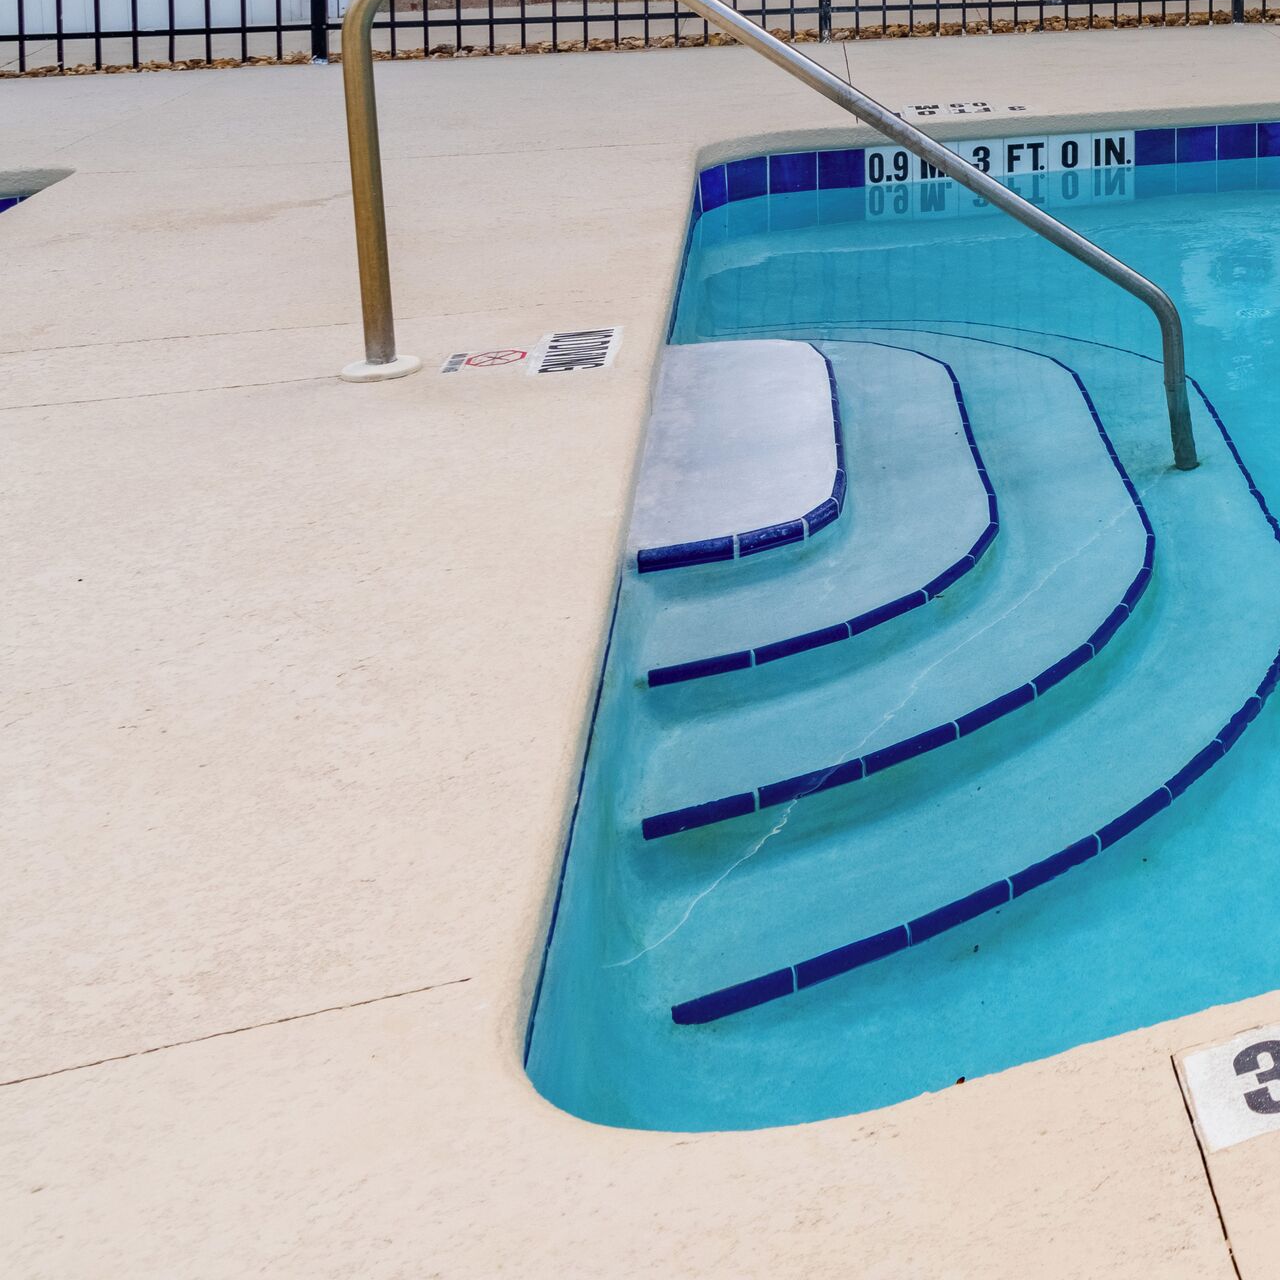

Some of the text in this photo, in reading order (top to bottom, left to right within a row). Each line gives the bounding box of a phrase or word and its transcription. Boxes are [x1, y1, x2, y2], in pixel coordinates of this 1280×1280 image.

[868, 151, 909, 183] 0.9
[972, 146, 991, 174] 3
[1007, 142, 1045, 173] FT.
[1061, 140, 1079, 168] 0
[1094, 137, 1132, 166] IN.
